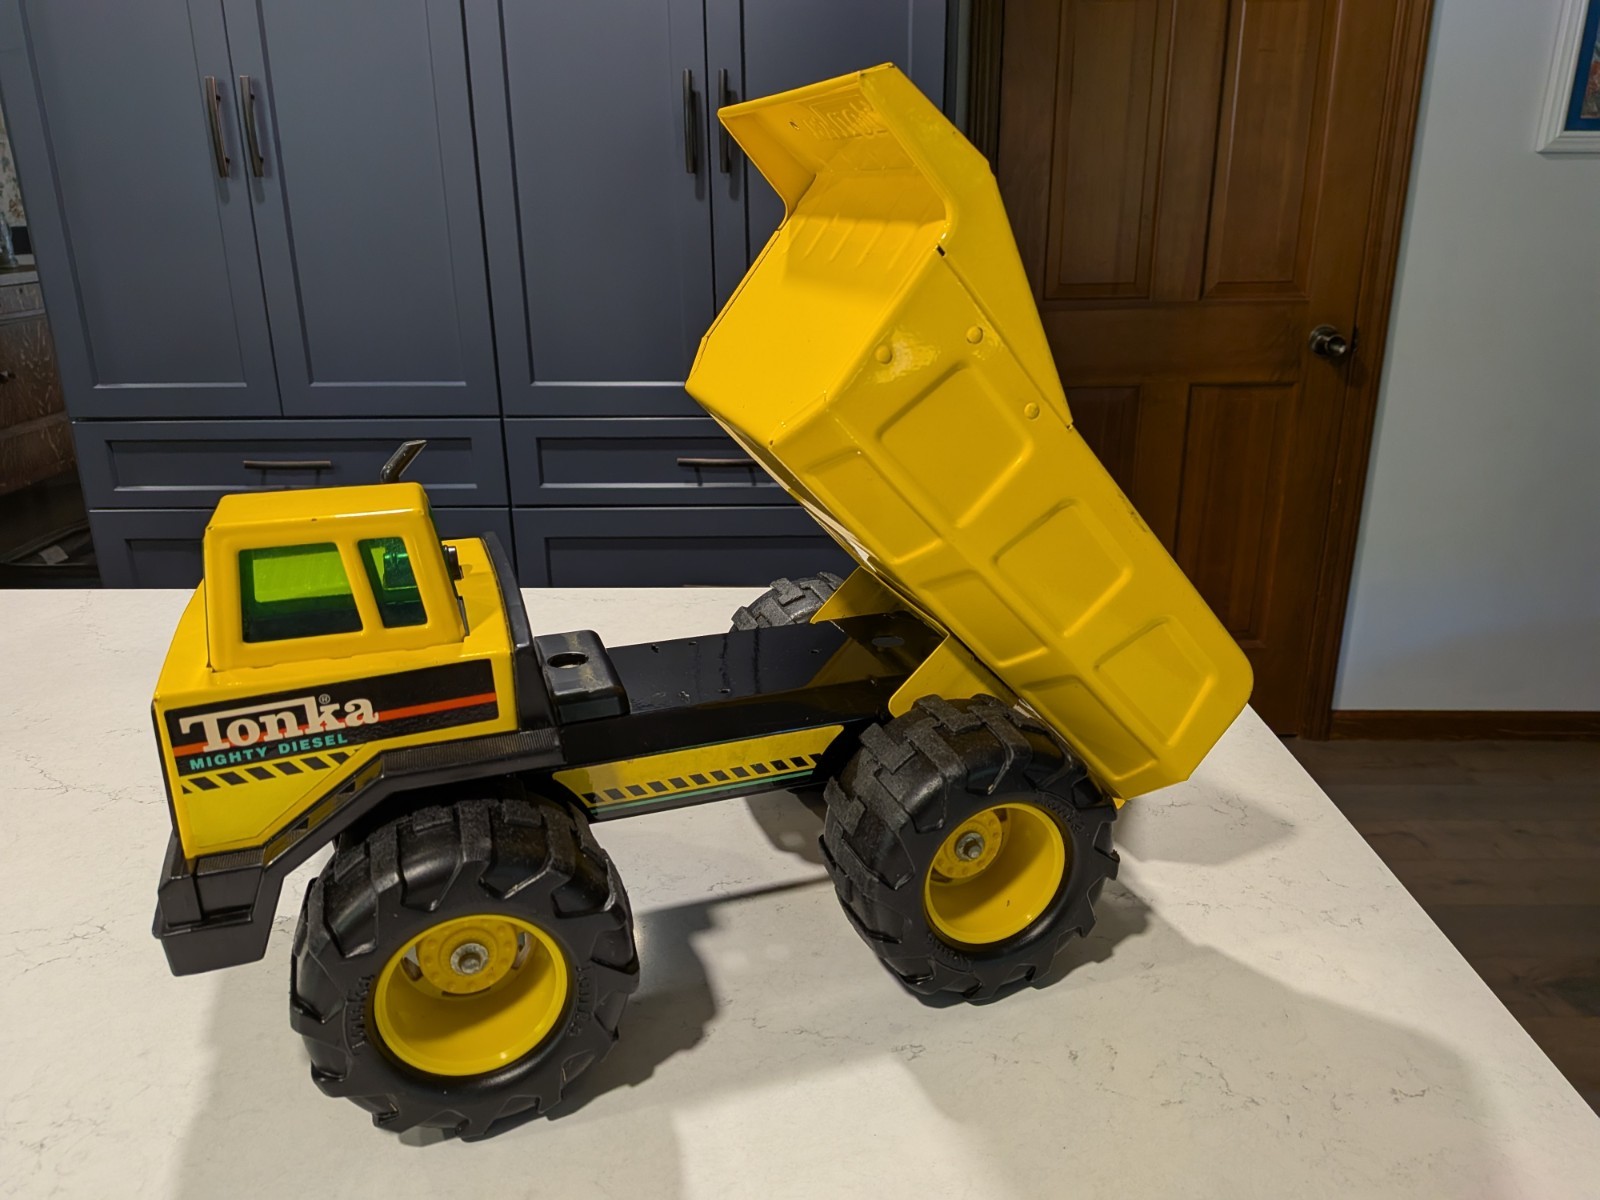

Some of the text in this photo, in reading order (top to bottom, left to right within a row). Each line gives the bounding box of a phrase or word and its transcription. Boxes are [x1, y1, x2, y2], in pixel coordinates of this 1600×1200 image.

[179, 694, 379, 753] Tonka
[190, 732, 349, 770] MIGHTY DIESEL
